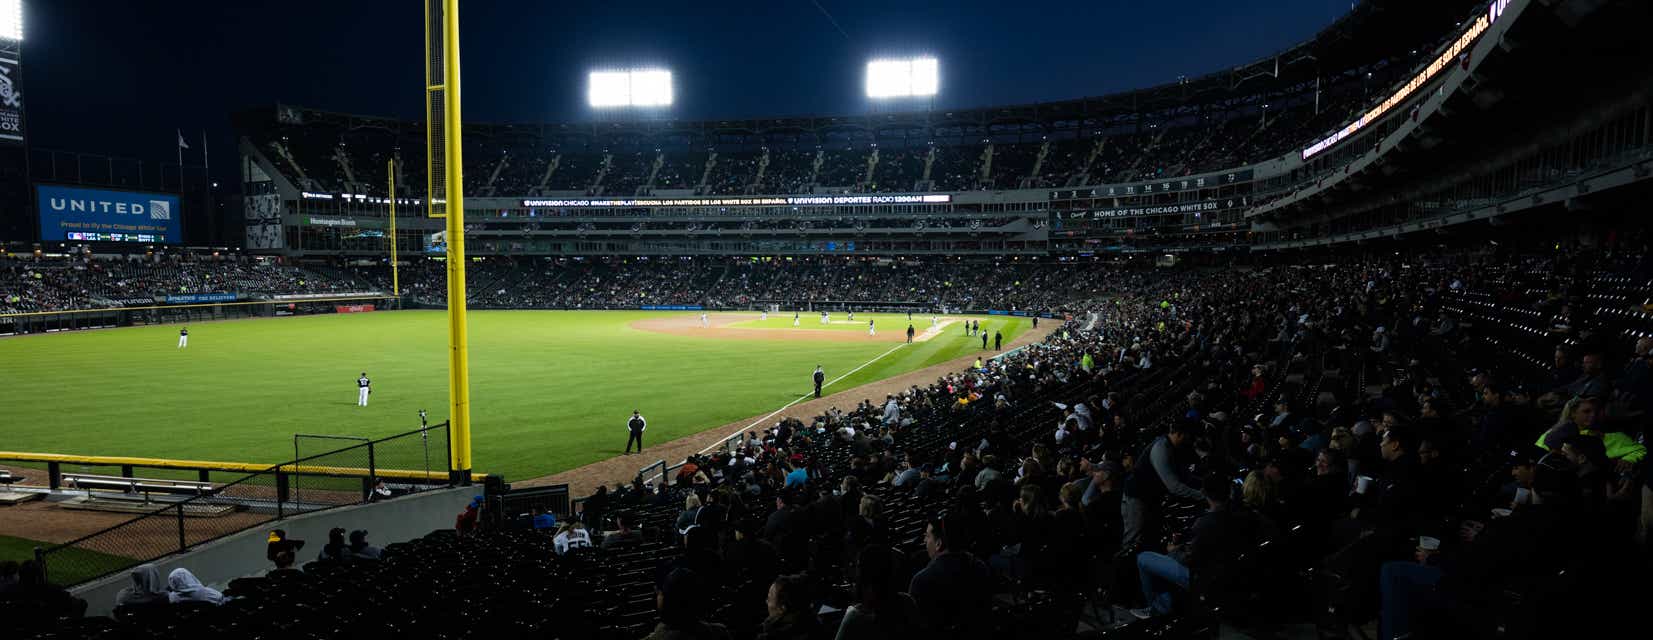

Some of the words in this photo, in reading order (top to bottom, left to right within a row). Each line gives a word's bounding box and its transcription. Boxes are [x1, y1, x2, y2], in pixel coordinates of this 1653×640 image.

[51, 198, 145, 215] UNITED
[1094, 210, 1116, 218] HOME
[1145, 206, 1179, 215] CHICAGO
[1180, 203, 1202, 212] WHITE
[1203, 202, 1217, 210] SOX
